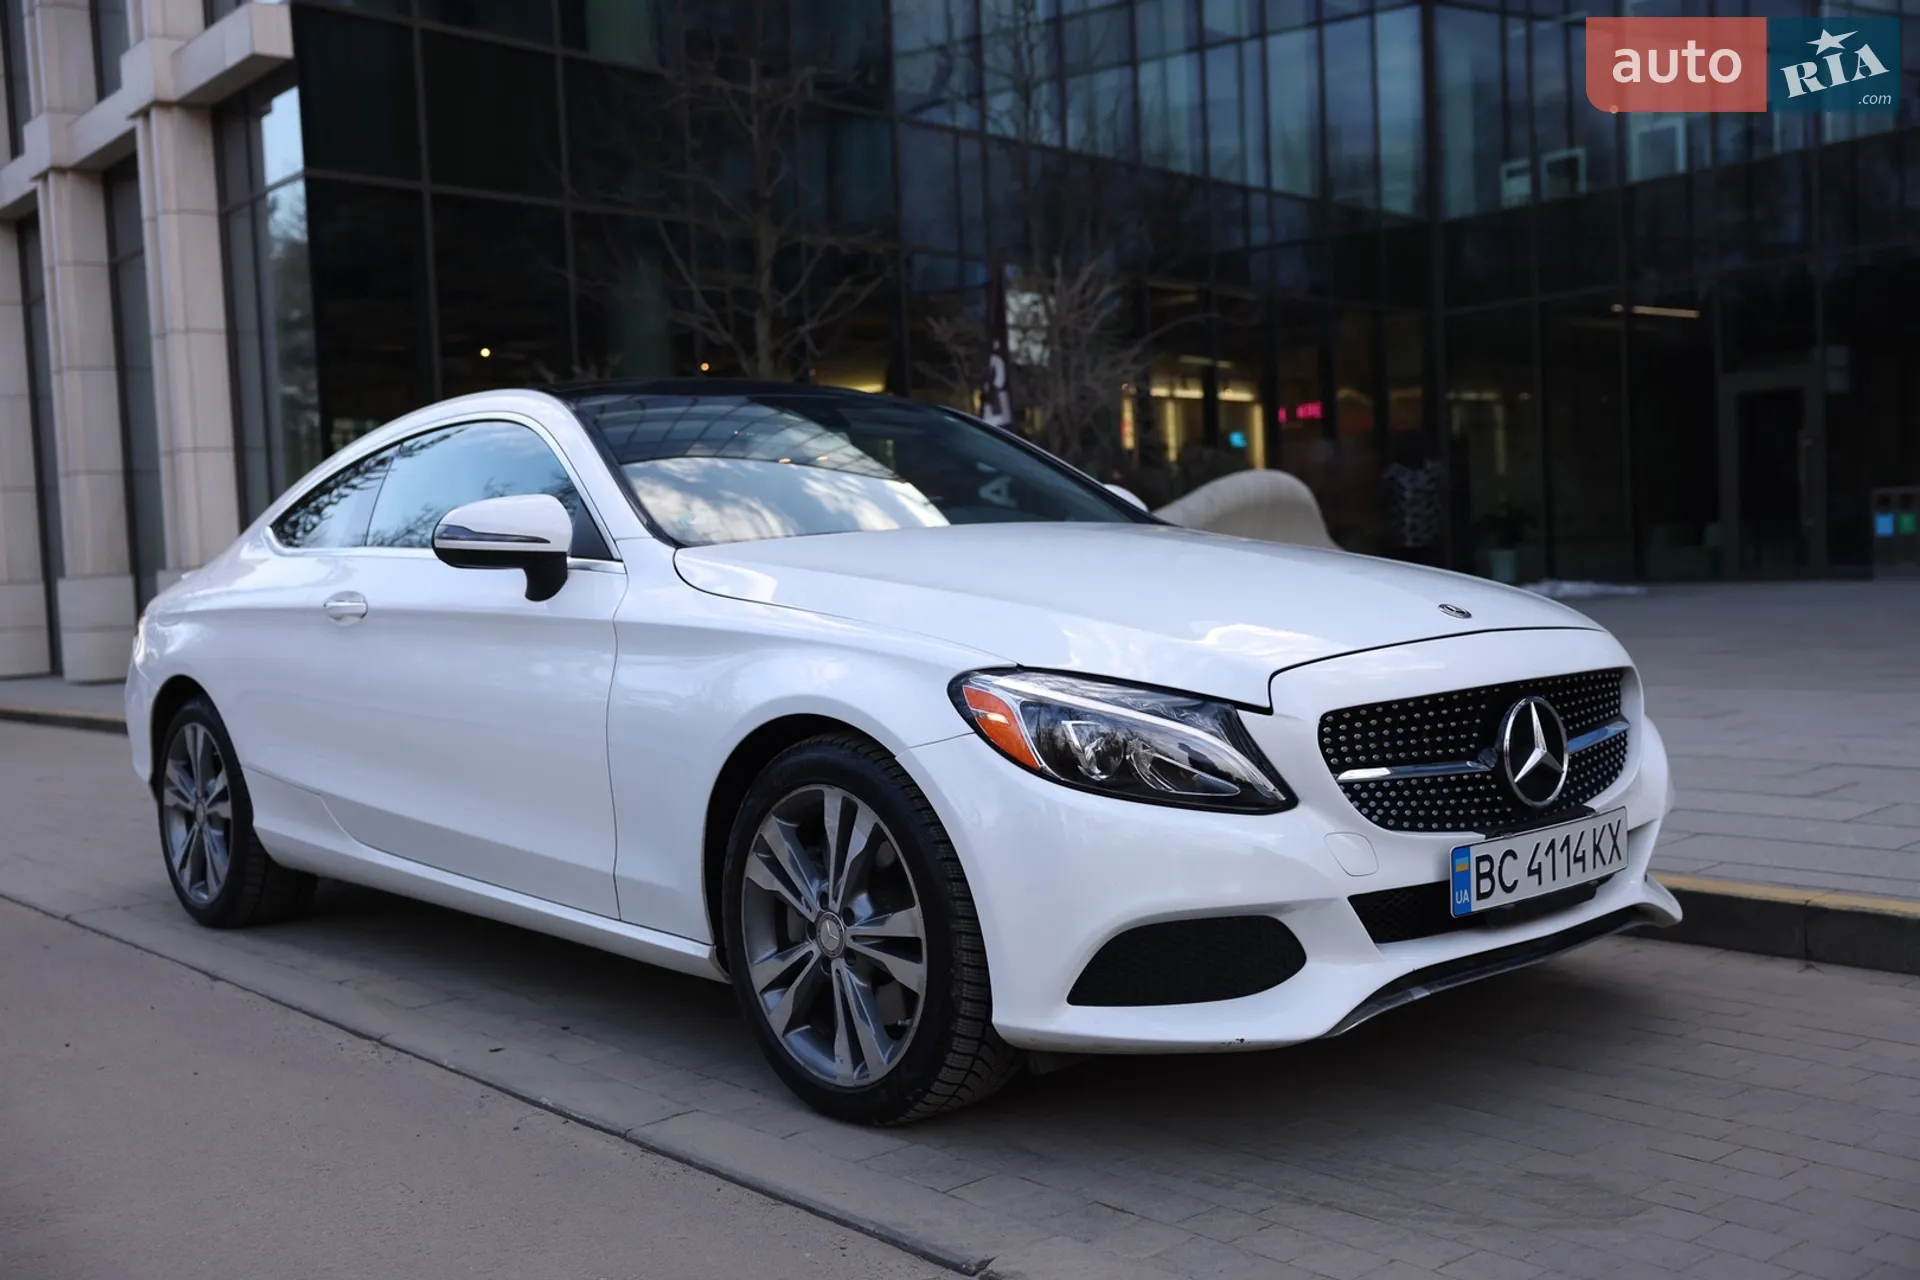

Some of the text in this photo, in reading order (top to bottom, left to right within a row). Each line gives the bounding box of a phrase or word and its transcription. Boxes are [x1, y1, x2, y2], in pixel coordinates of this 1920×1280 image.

[1475, 819, 1623, 901] BC 4114 KX
[1456, 889, 1470, 904] UA
